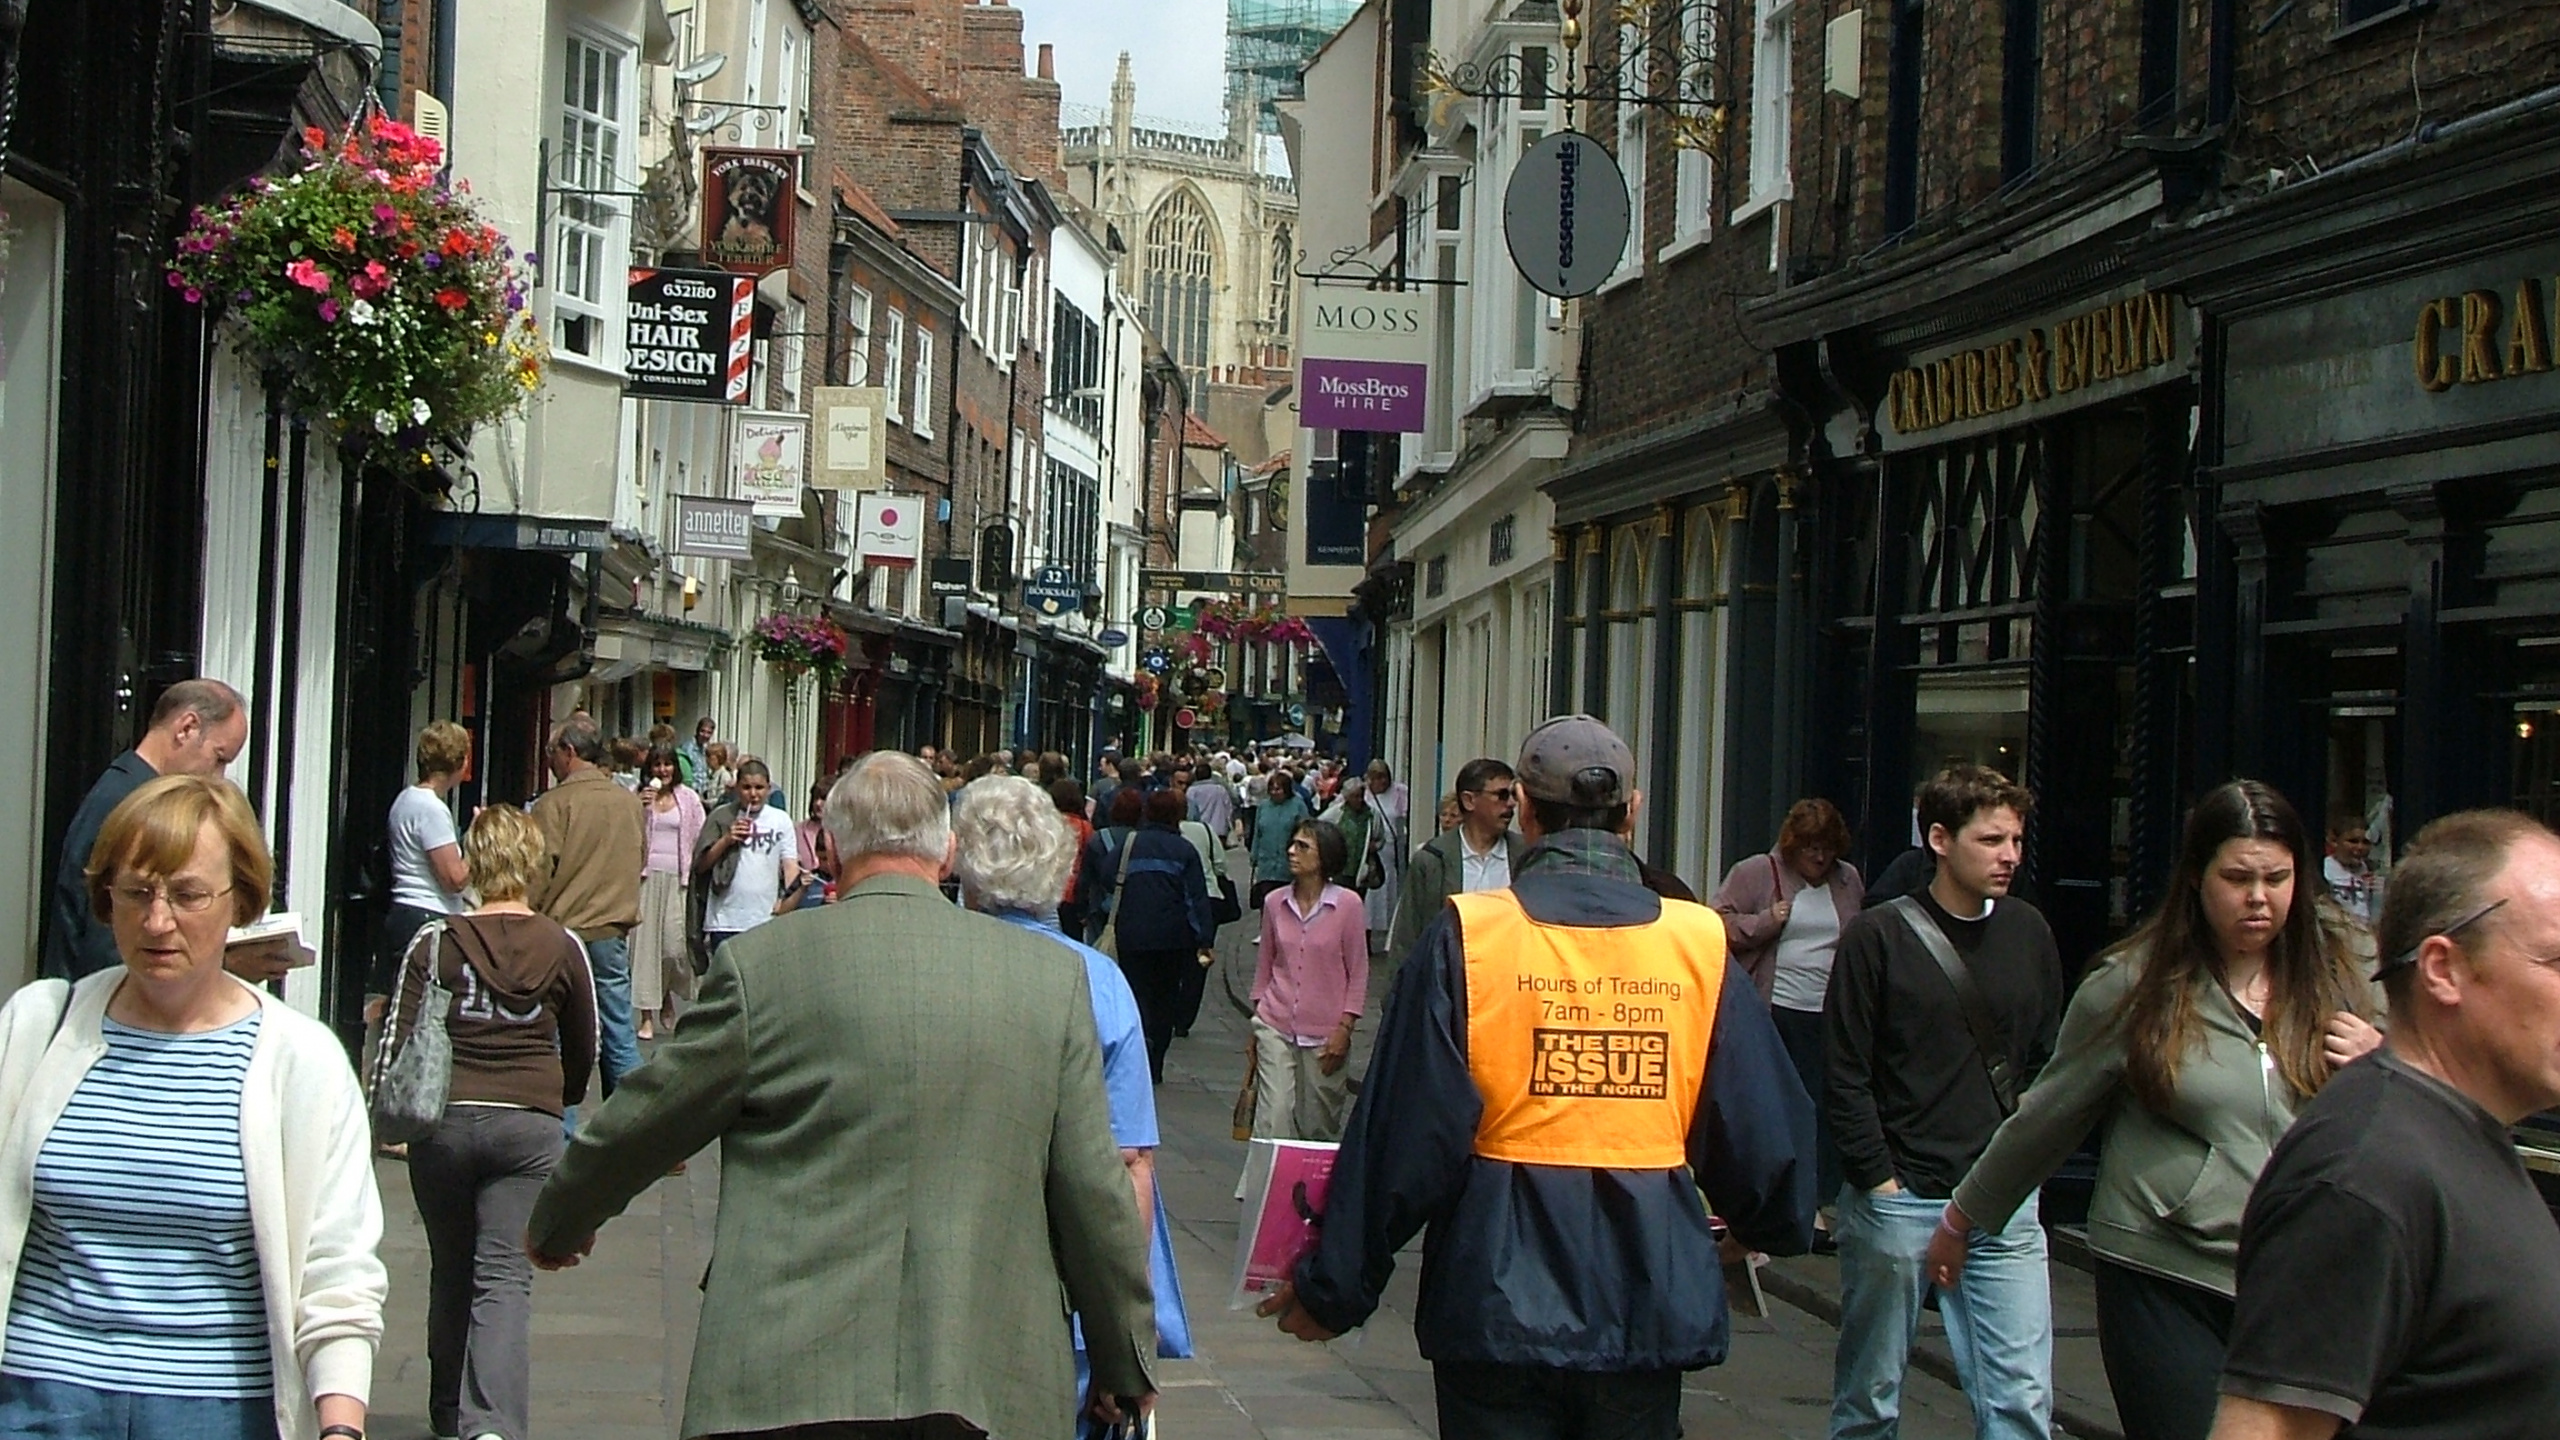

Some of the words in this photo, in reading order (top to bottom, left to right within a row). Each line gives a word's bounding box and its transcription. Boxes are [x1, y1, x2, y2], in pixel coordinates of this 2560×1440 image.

[711, 159, 740, 177] YORK
[743, 158, 789, 180] BREWERY
[1556, 140, 1575, 268] essensuals
[662, 283, 717, 299] 632180
[628, 301, 709, 325] Uni-Sex
[1316, 304, 1419, 332] MOSS
[629, 322, 700, 349] HAIR
[2414, 273, 2560, 393] CRA
[1888, 337, 2023, 434] CRABTREE
[2024, 328, 2051, 402] &
[2054, 291, 2175, 394] EVELYN
[1319, 376, 1409, 398] MossBros
[1334, 396, 1392, 411] HIRE
[685, 508, 742, 535] annette
[1045, 570, 1062, 584] 32
[1517, 974, 1577, 993] Hours
[1583, 976, 1603, 994] of
[1609, 977, 1681, 1001] Trading
[1541, 1000, 1590, 1022] 7am
[1612, 1002, 1664, 1028] 8pm
[1539, 1033, 1604, 1051] THE
[1607, 1034, 1664, 1053] BIG
[1534, 1050, 1664, 1085] ISSUE
[1534, 1082, 1554, 1094] IN
[1560, 1083, 1596, 1095] THE
[1601, 1084, 1663, 1097] NORTH
